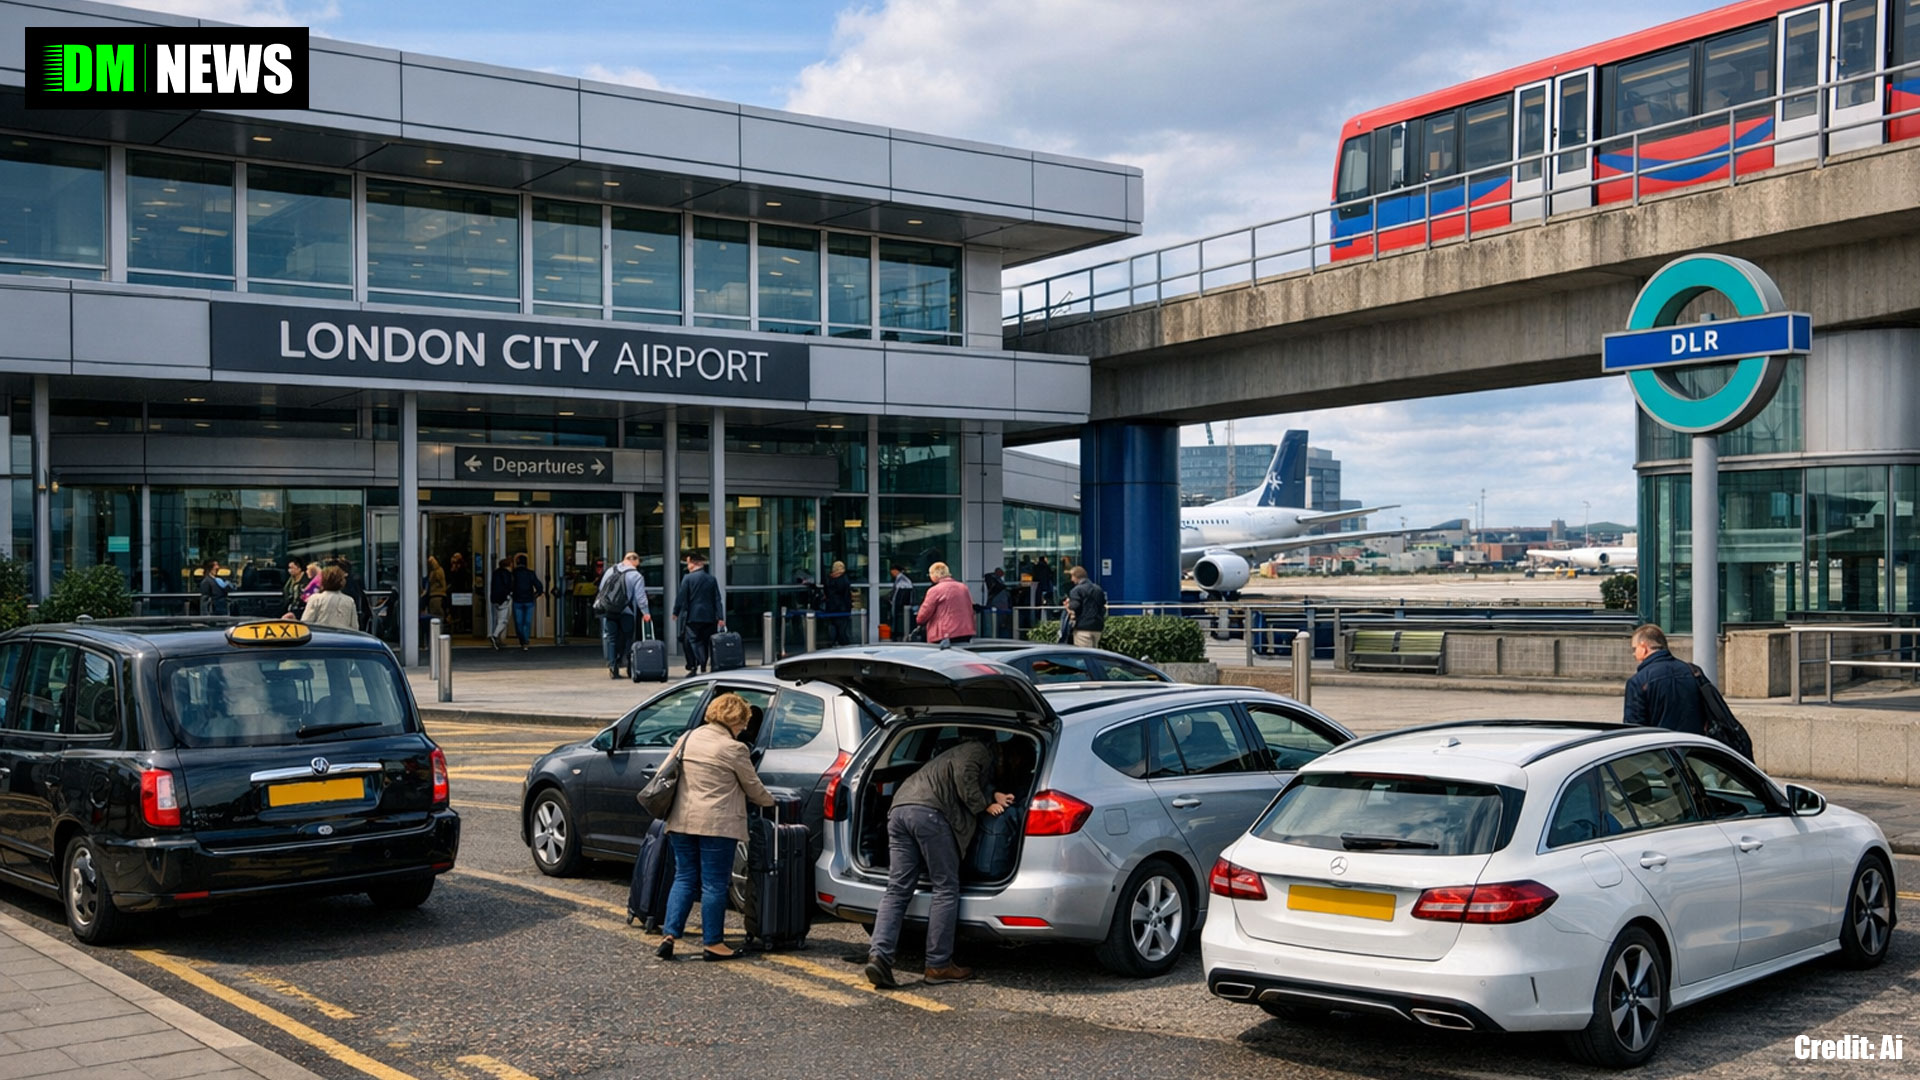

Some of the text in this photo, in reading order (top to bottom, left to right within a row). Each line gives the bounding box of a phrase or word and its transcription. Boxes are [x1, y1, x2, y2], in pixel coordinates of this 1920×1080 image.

[280, 320, 769, 383] LONDON CITY AIRPORT
[1671, 330, 1719, 355] DLR
[493, 456, 585, 477] Departures
[249, 624, 299, 639] TAXI
